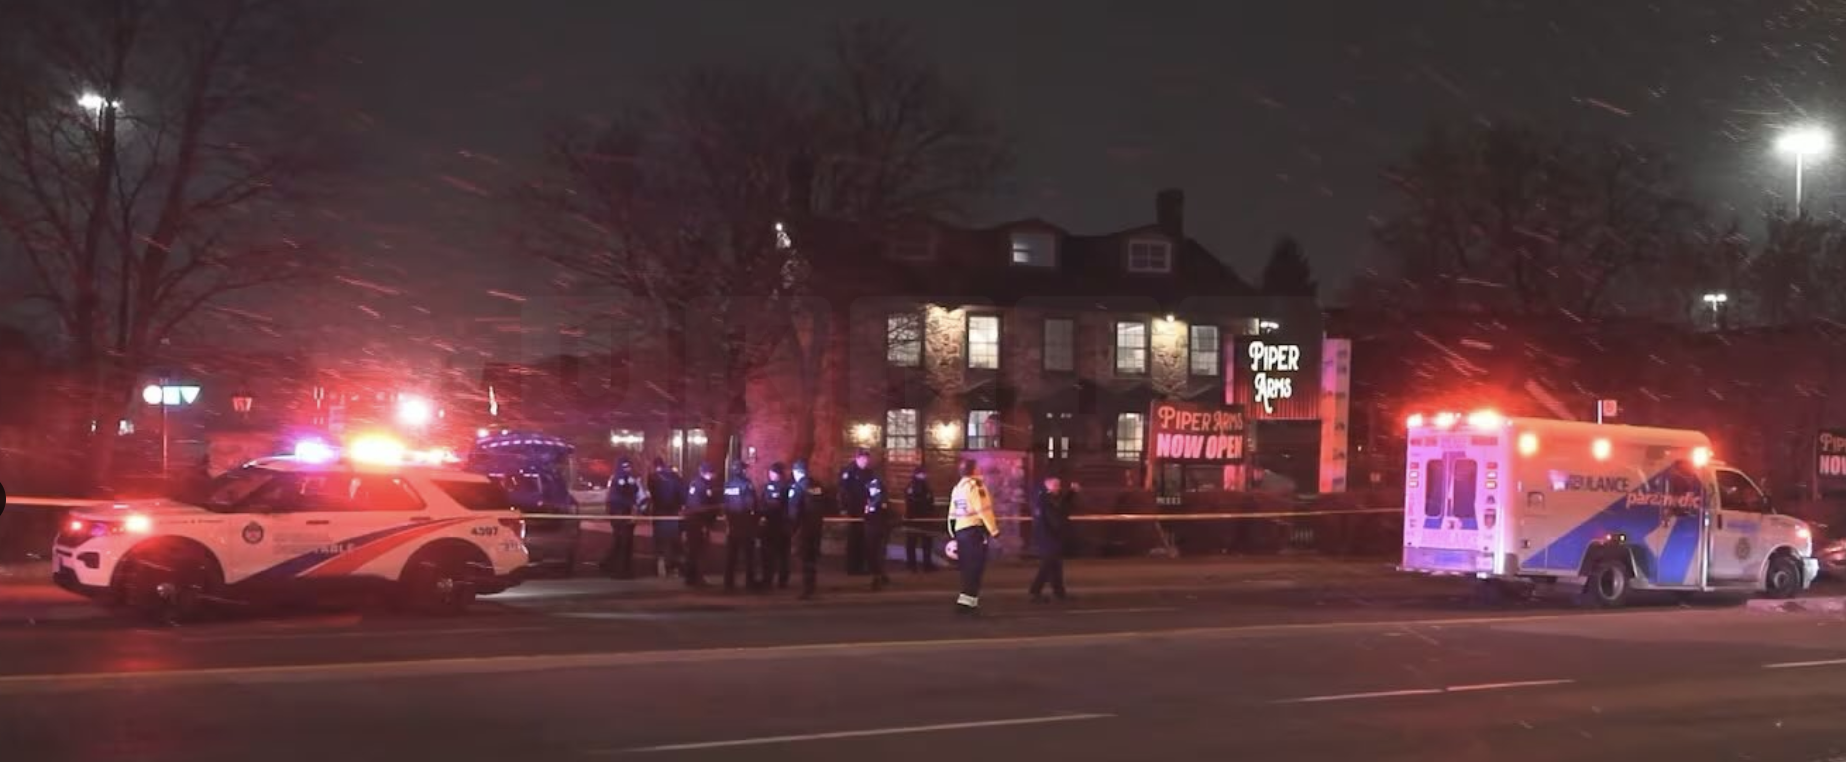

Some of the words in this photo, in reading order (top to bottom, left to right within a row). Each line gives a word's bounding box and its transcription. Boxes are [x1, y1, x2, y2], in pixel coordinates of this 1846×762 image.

[1248, 341, 1300, 371] PIPER
[1254, 372, 1292, 414] ARMS
[1158, 405, 1212, 431] PIPER
[1213, 409, 1243, 434] ARMS
[1156, 433, 1204, 459] NOW
[1205, 435, 1243, 460] OPEN
[1820, 432, 1846, 452] PIP
[1549, 474, 1629, 493] BULANCE
[1626, 492, 1701, 510] paramdic
